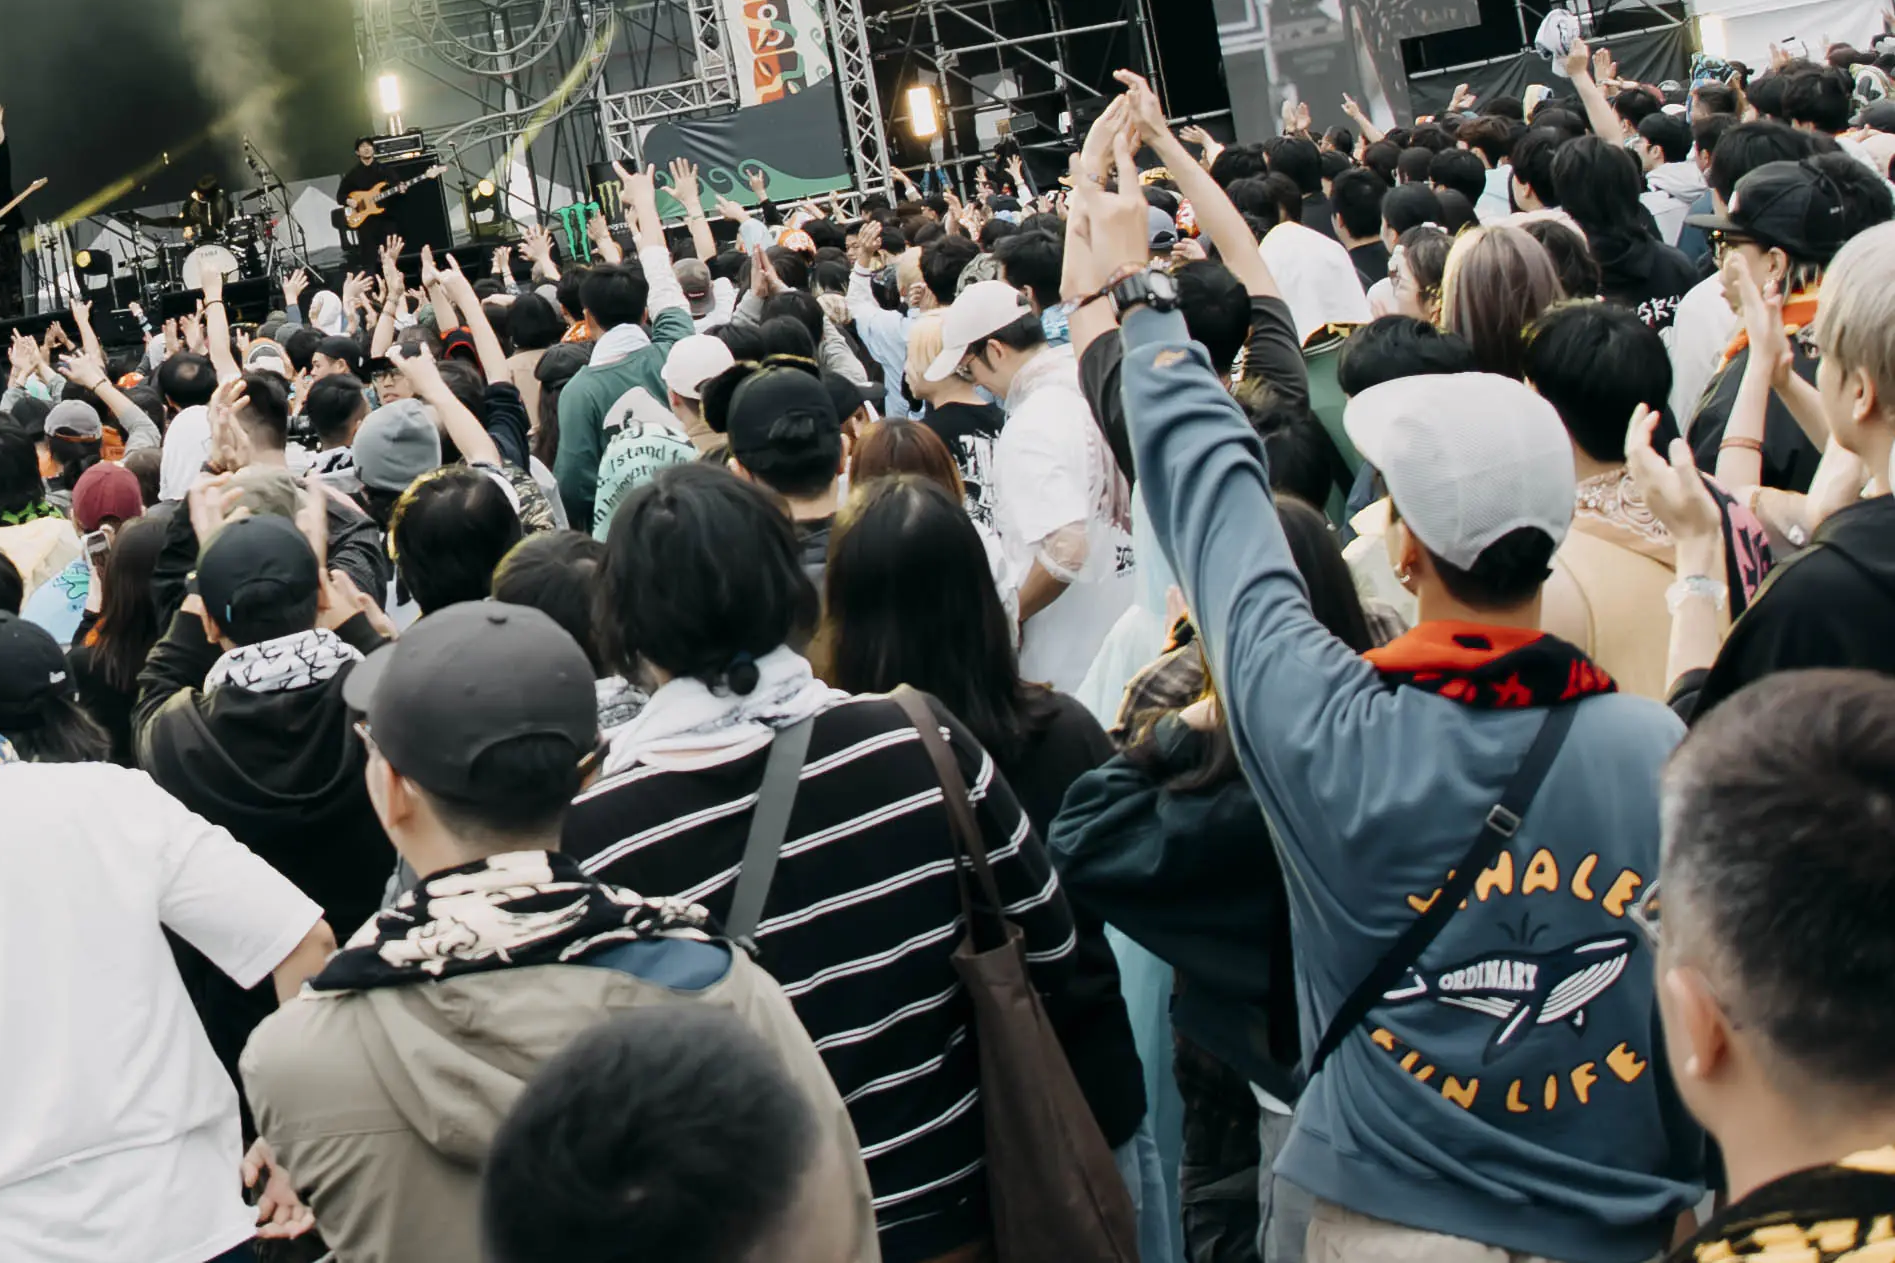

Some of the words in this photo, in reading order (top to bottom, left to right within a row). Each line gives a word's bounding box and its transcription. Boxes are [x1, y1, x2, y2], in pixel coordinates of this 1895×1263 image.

[616, 445, 666, 467] stand
[1438, 959, 1538, 991] ORDINARY
[1506, 1041, 1648, 1113] LIFE
